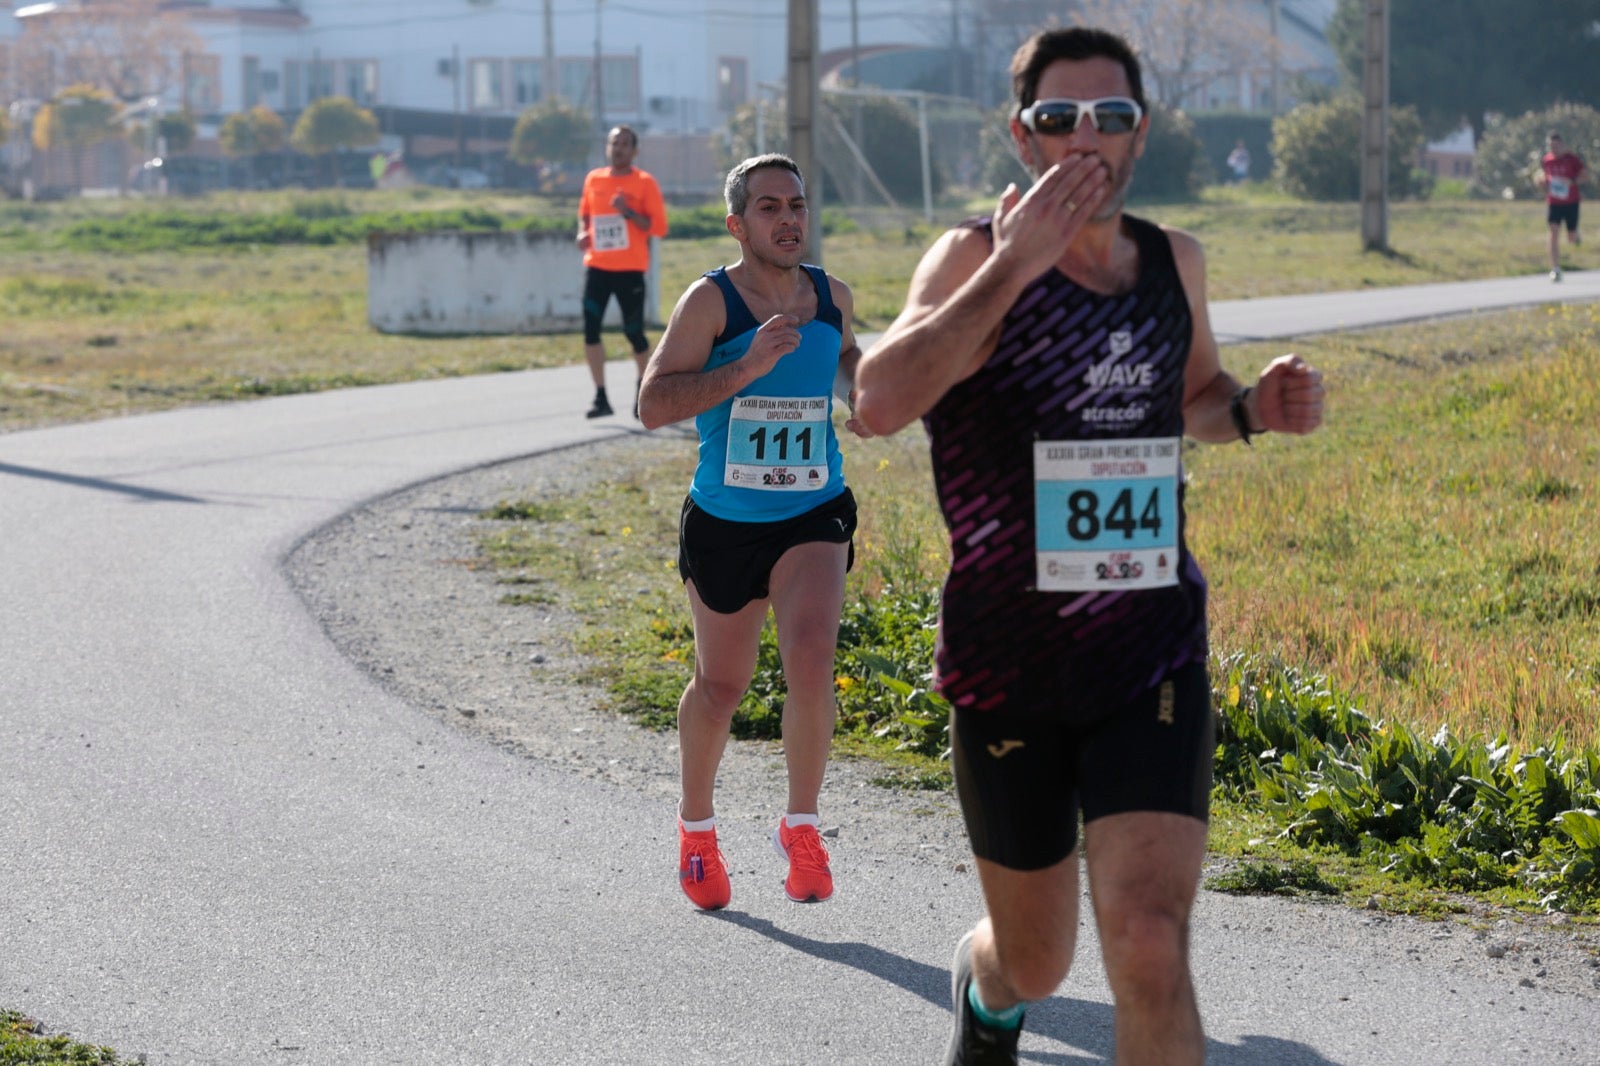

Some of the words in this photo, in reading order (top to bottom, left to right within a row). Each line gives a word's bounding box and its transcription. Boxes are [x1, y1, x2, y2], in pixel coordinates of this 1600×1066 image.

[1083, 363, 1153, 386] WAVE
[759, 400, 777, 409] GRAN
[777, 400, 799, 410] PREMIO
[800, 400, 808, 409] DE
[766, 410, 803, 420] DIPUTACIÓN
[749, 426, 811, 461] 111
[1066, 486, 1162, 541] 844
